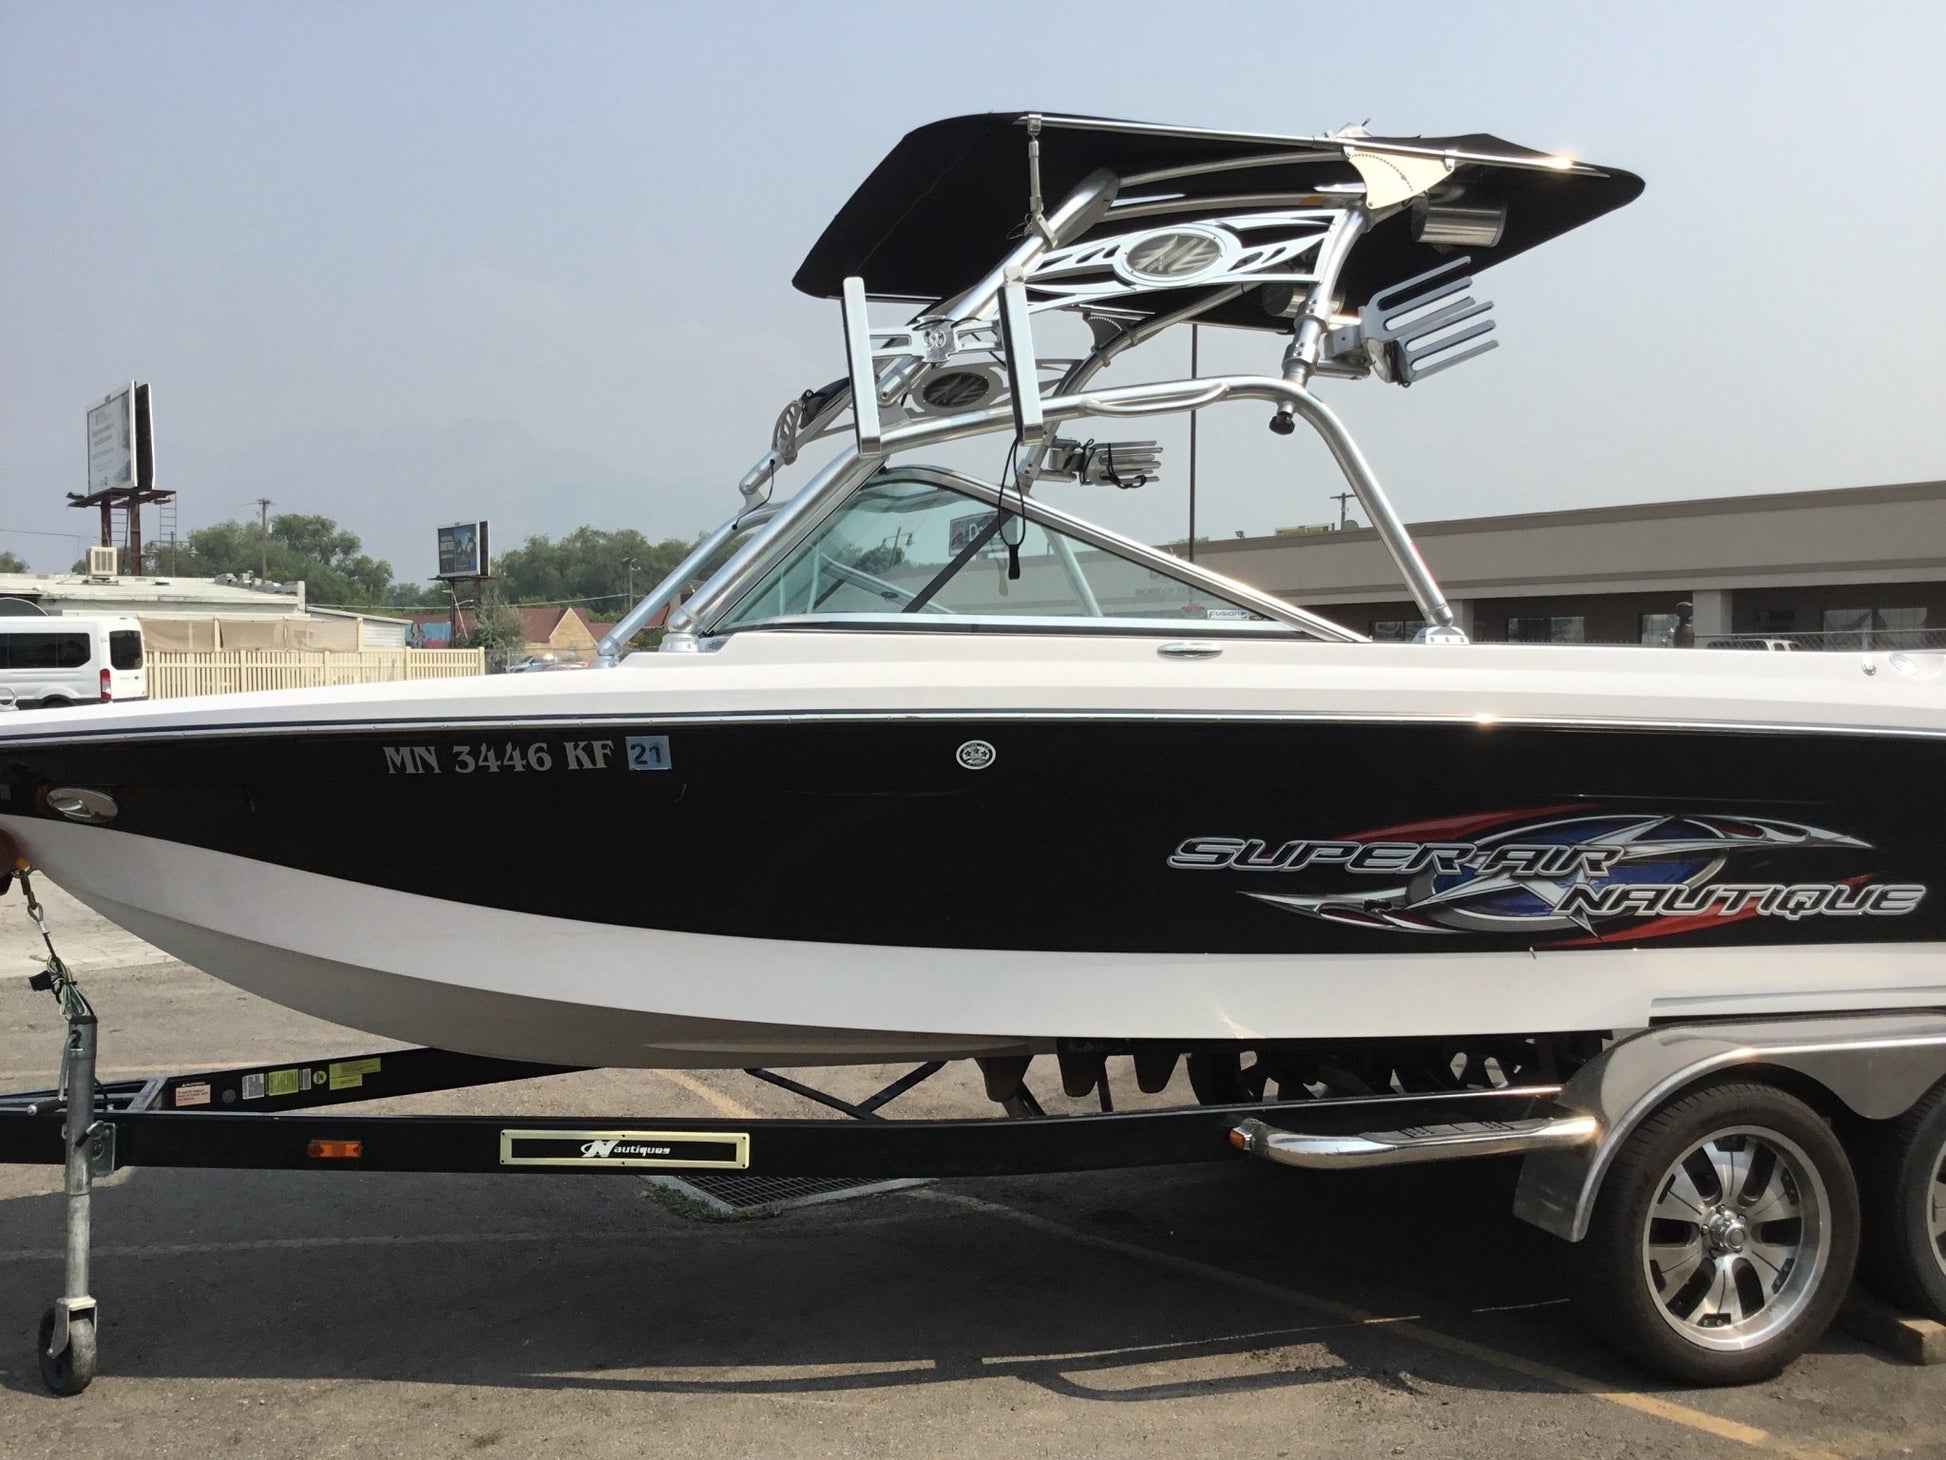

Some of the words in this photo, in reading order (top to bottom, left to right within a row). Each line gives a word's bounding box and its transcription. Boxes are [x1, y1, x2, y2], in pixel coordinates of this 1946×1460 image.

[382, 746, 442, 774] MN
[451, 741, 552, 773] 3446
[563, 739, 615, 770] KF
[630, 742, 662, 765] 21
[1167, 837, 1478, 875] SUPER
[1475, 843, 1625, 877] AIR
[1551, 883, 1927, 920] NAUTIQUE
[580, 1140, 671, 1158] Nautiques
